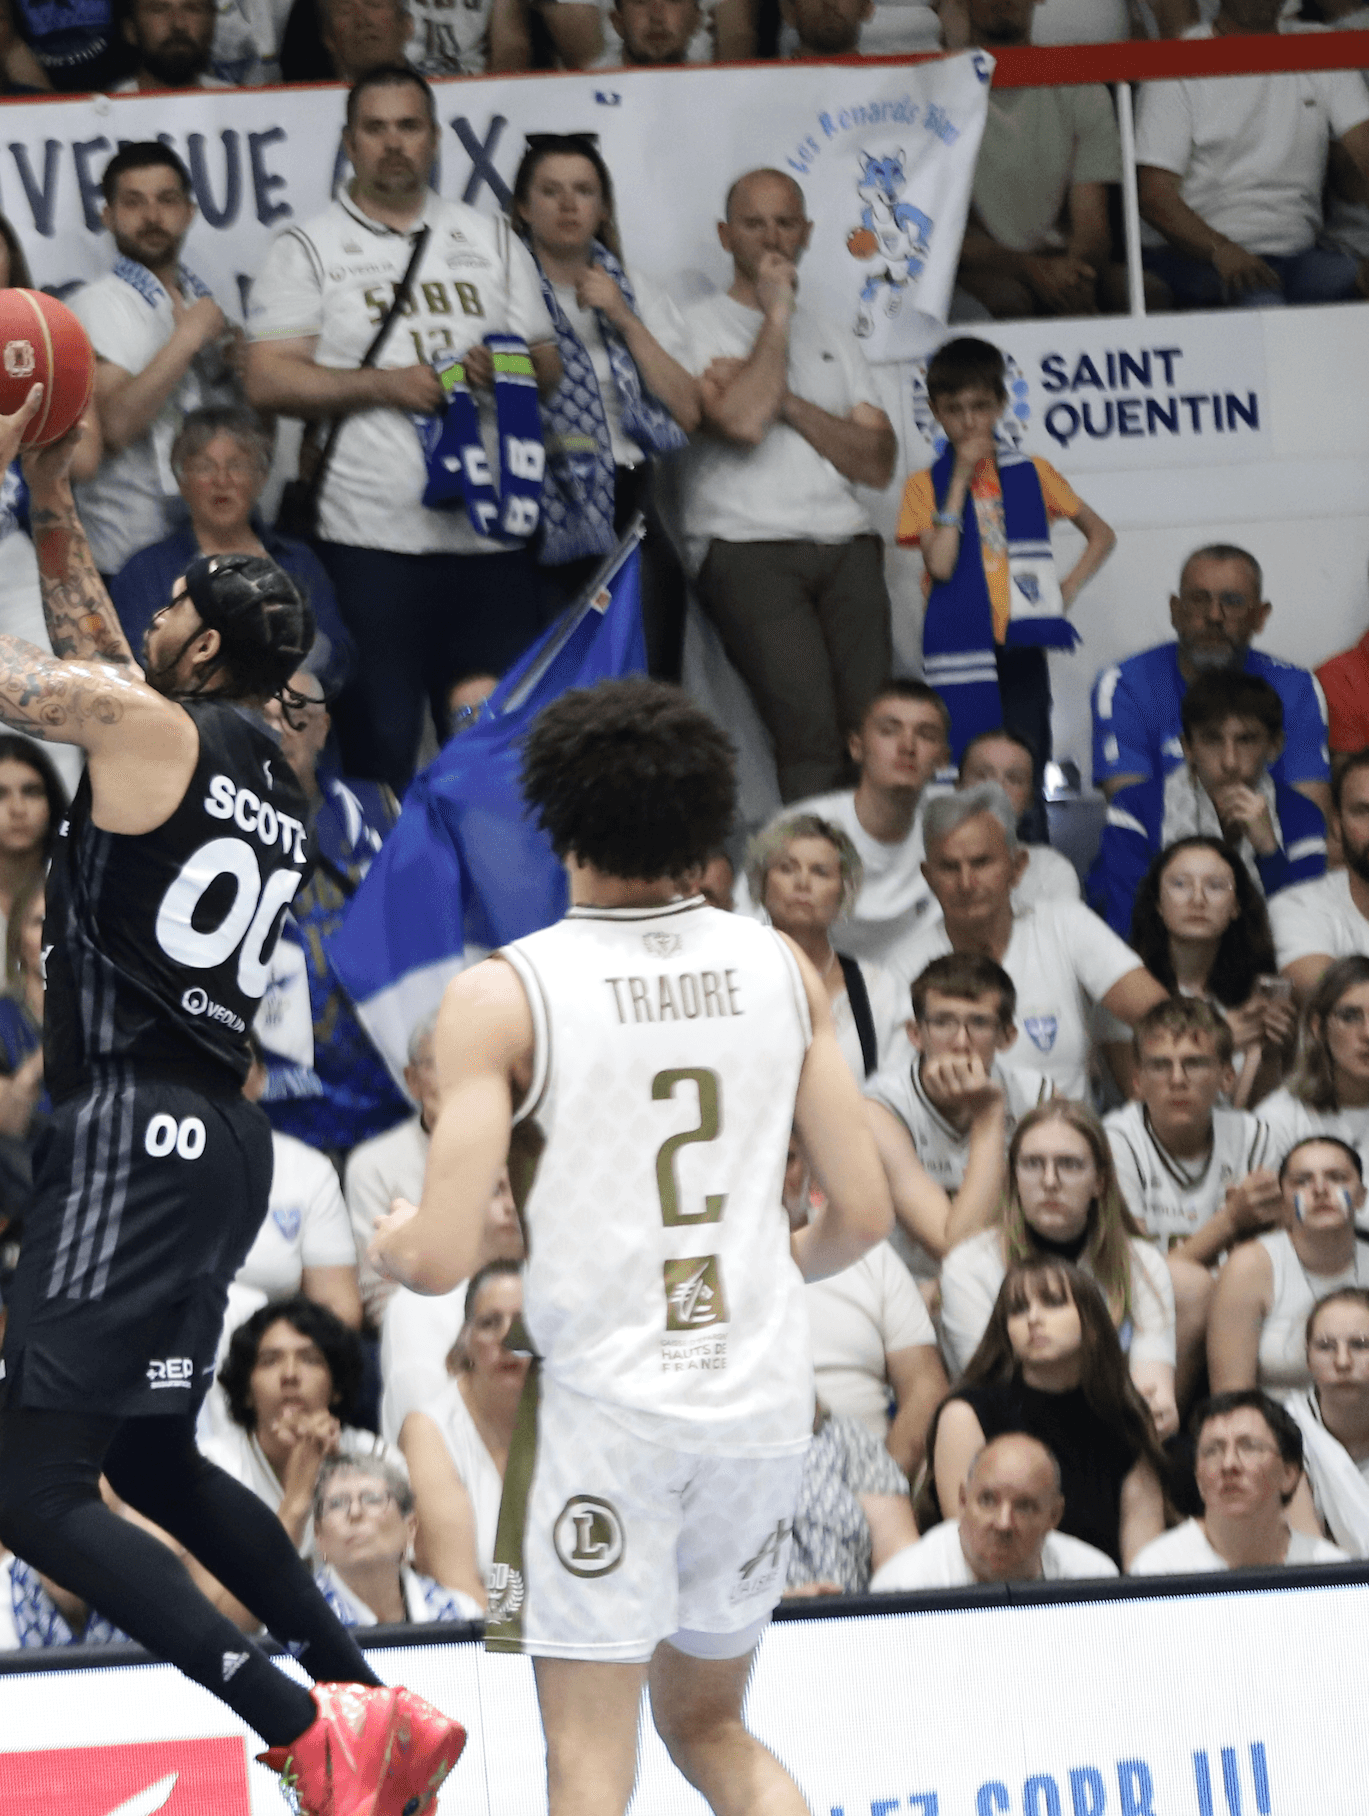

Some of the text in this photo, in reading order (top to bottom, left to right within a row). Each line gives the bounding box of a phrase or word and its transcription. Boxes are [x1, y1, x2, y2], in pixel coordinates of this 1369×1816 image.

[1040, 348, 1183, 393] SAINT
[1043, 391, 1260, 448] QUENTIN
[155, 837, 303, 998] 00
[207, 1001, 246, 1034] VEOLIA
[604, 968, 746, 1024] TRAORE
[144, 1112, 207, 1160] 00
[651, 1066, 730, 1228] 2
[661, 1344, 711, 1361] HAUTS
[661, 1357, 727, 1374] FRANCE
